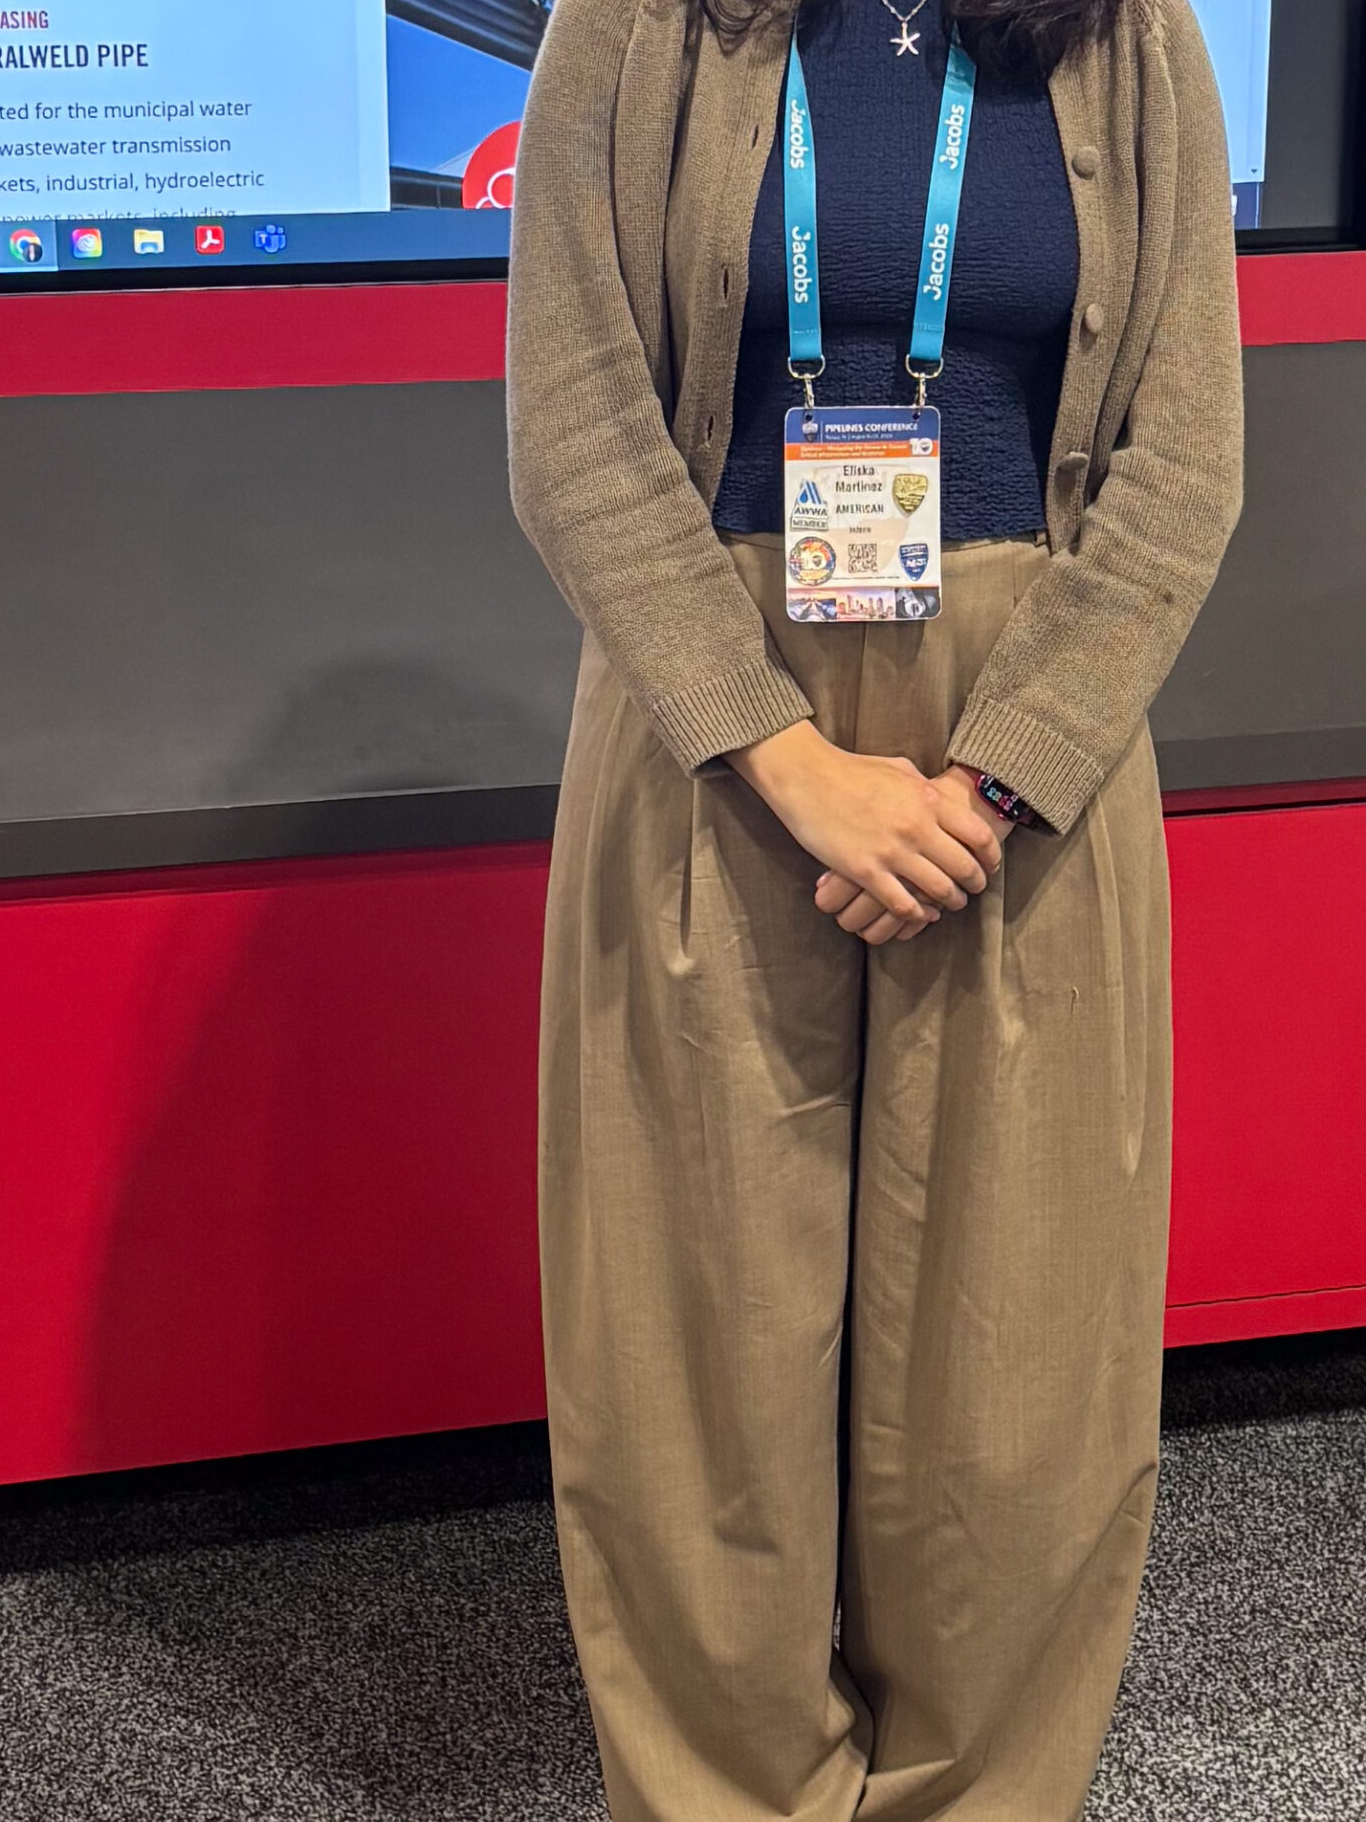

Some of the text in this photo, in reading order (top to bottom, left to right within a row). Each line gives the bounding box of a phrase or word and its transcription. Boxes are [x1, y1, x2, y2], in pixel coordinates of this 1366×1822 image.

[98, 43, 148, 68] PIPE
[36, 102, 61, 119] for
[68, 102, 98, 119] the
[105, 100, 193, 121] municipal
[200, 101, 251, 116] water
[112, 136, 230, 154] transmission
[790, 99, 810, 171] Jacobs
[939, 103, 966, 170] Jacobs
[47, 172, 138, 192] industrial,
[145, 171, 264, 193] hydroelectric
[791, 226, 813, 304] Jacobs
[923, 223, 950, 301] Jacobs
